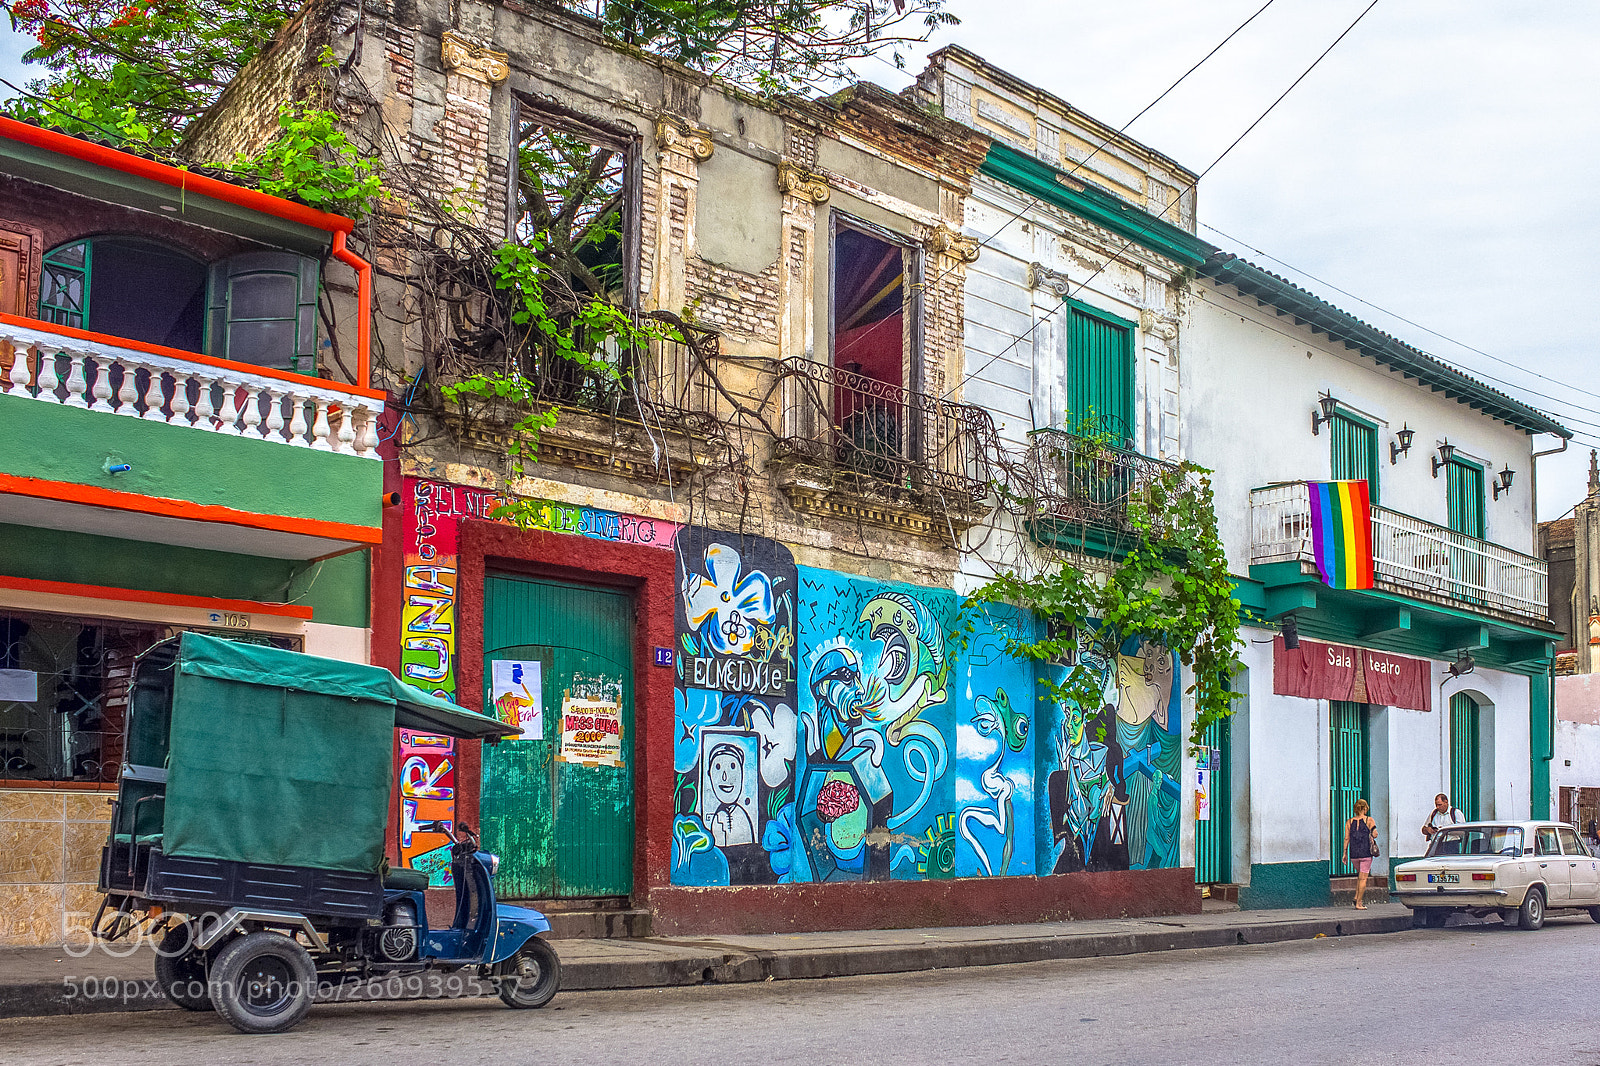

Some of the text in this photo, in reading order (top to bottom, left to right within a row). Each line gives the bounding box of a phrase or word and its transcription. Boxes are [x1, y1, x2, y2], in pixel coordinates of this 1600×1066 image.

[435, 484, 462, 520] EL
[553, 506, 575, 533] DE
[223, 612, 249, 628] 105
[657, 650, 672, 664] 12
[1327, 646, 1401, 676] Sala teatro
[694, 657, 716, 689] EL
[595, 718, 619, 735] CUBA
